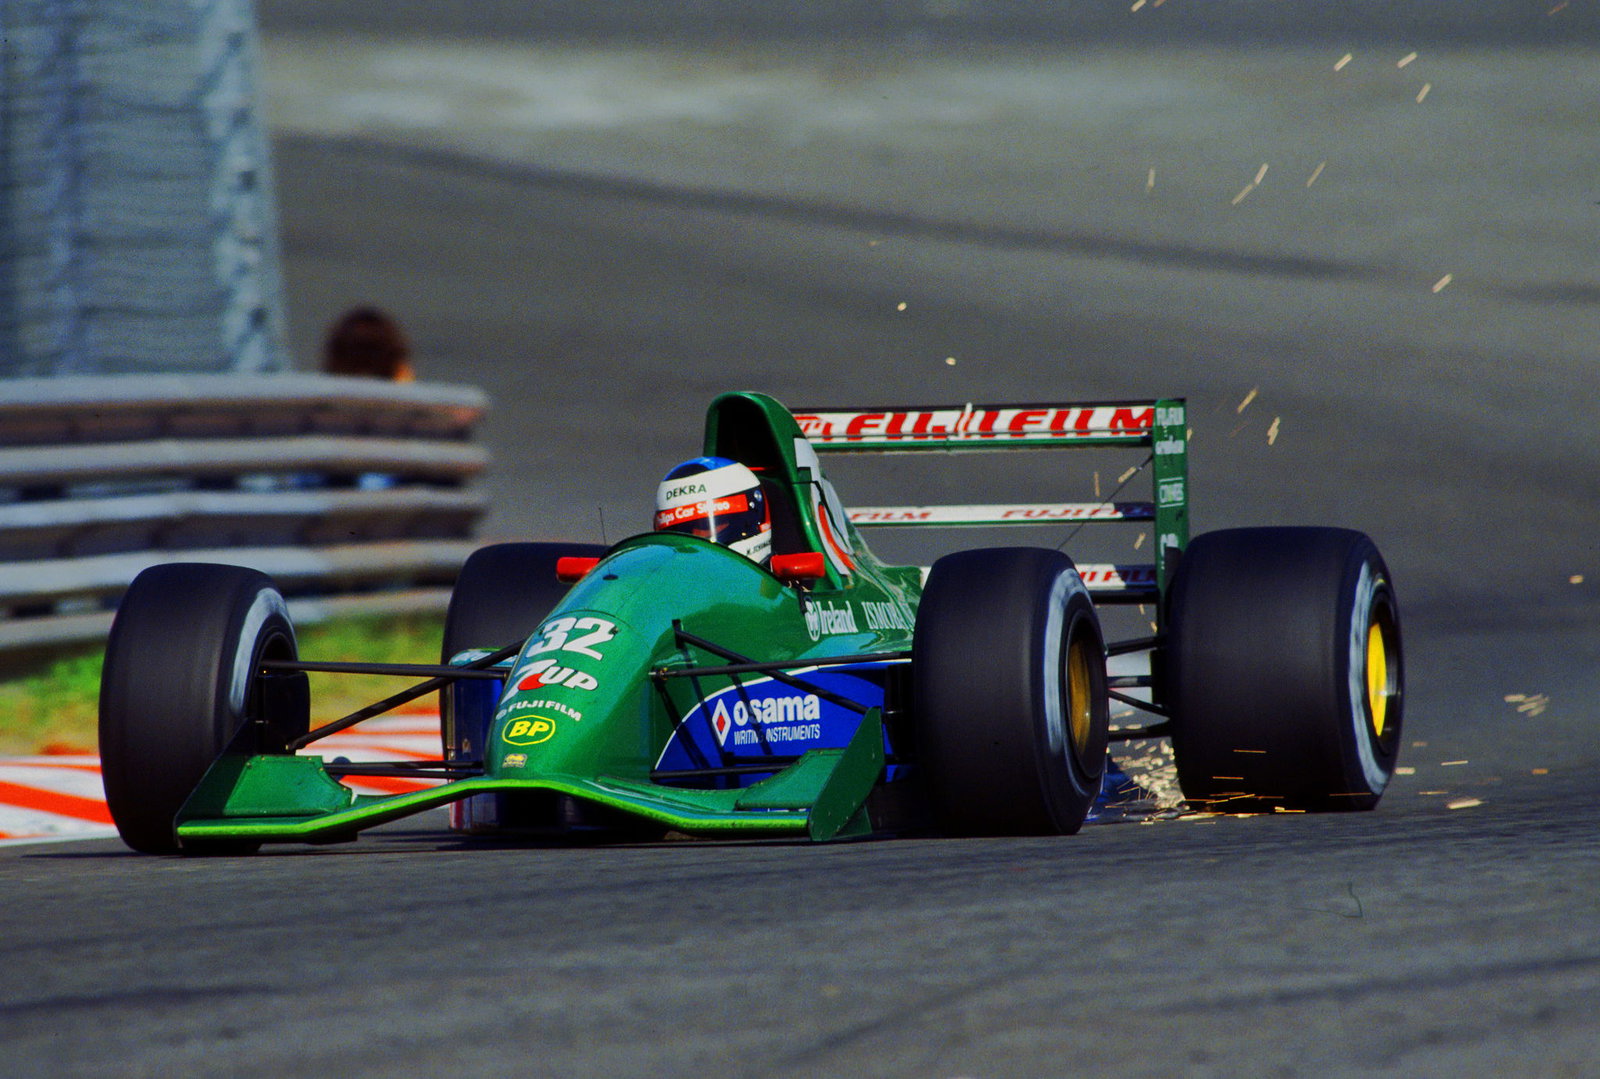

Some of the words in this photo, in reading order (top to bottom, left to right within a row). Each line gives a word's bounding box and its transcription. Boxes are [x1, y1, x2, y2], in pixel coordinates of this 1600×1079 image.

[665, 484, 707, 501] DEKRA
[675, 507, 695, 519] Car
[817, 600, 858, 635] Ireland
[526, 617, 616, 661] 32
[508, 700, 544, 717] FUJI
[545, 701, 582, 722] FILM
[733, 694, 820, 727] osama
[508, 720, 550, 738] BP
